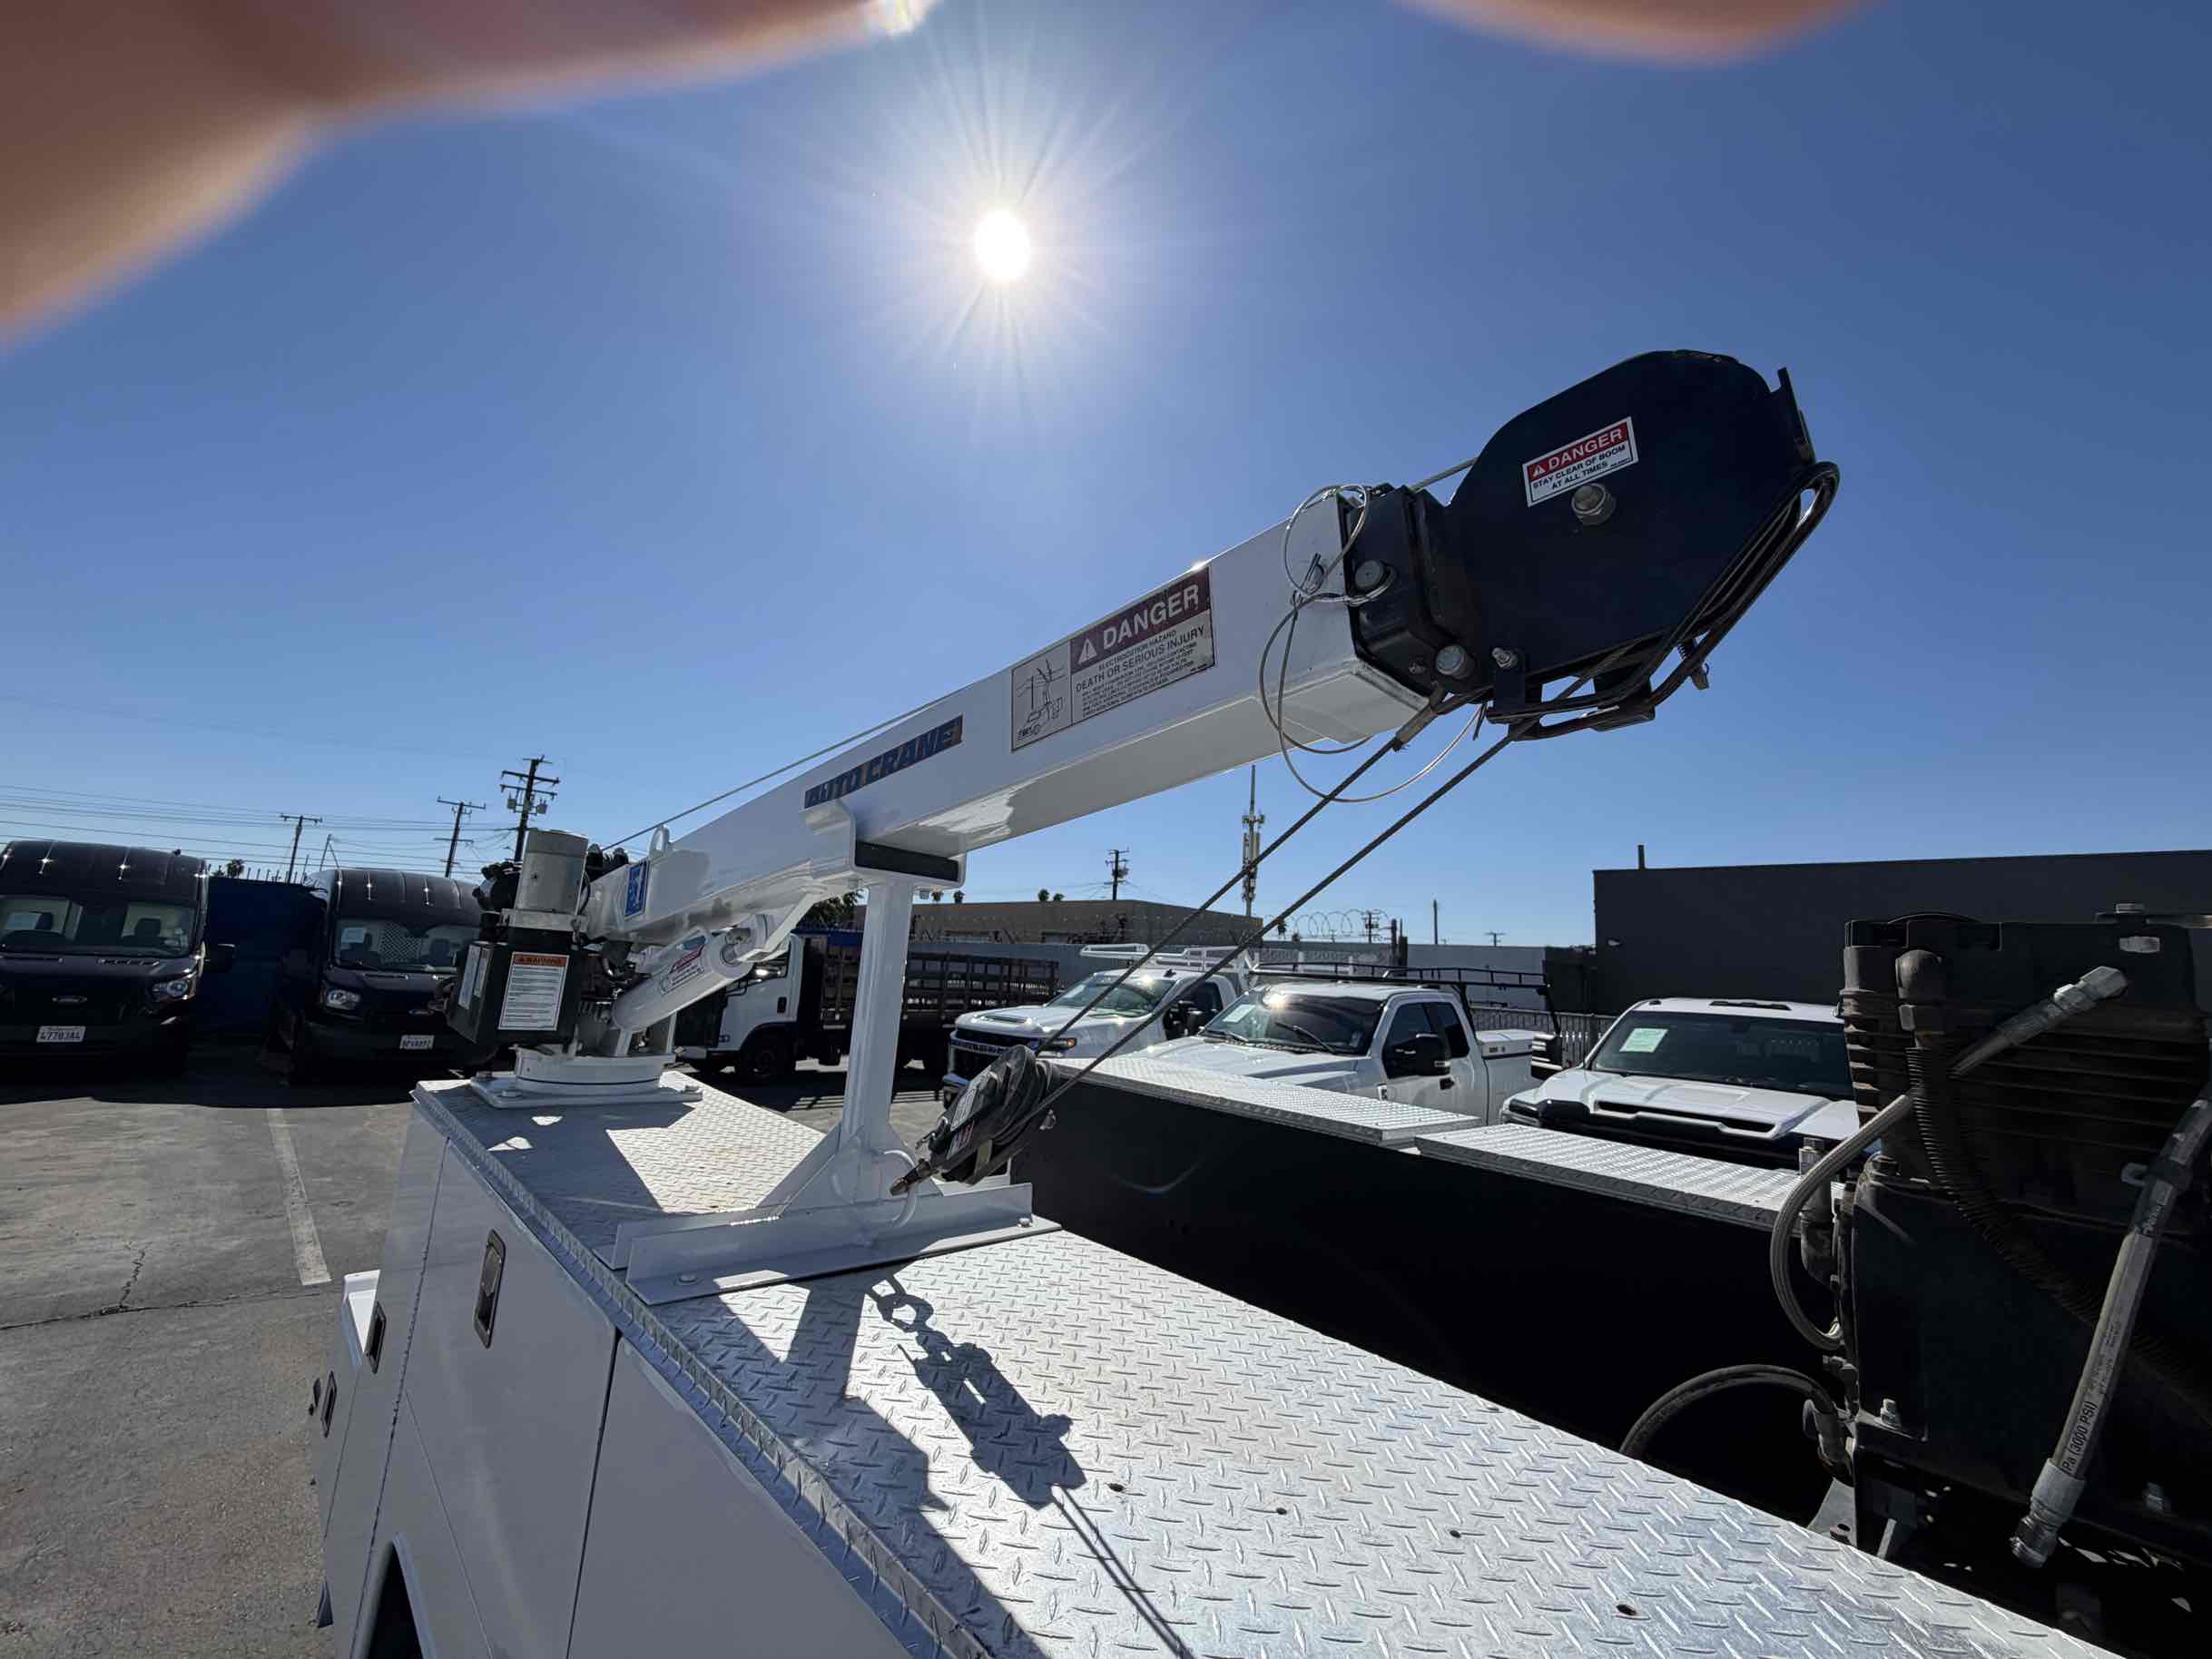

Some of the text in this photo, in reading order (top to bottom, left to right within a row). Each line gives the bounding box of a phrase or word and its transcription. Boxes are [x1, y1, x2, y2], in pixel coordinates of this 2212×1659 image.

[1532, 475, 1556, 488] STAY
[1556, 463, 1585, 478] CLEAR
[1586, 456, 1598, 466] OF
[1599, 444, 1626, 460] BOOM
[1548, 428, 1622, 469] DANGER
[1552, 481, 1563, 490] AT
[1565, 473, 1580, 484] ALL
[1582, 461, 1608, 477] TIMES
[1103, 584, 1199, 650] DANGER
[1076, 624, 1205, 692] DEATH OR SERIOUS INJURY
[2068, 1425, 2088, 1457] (3000
[2079, 1400, 2099, 1425] PSI)
